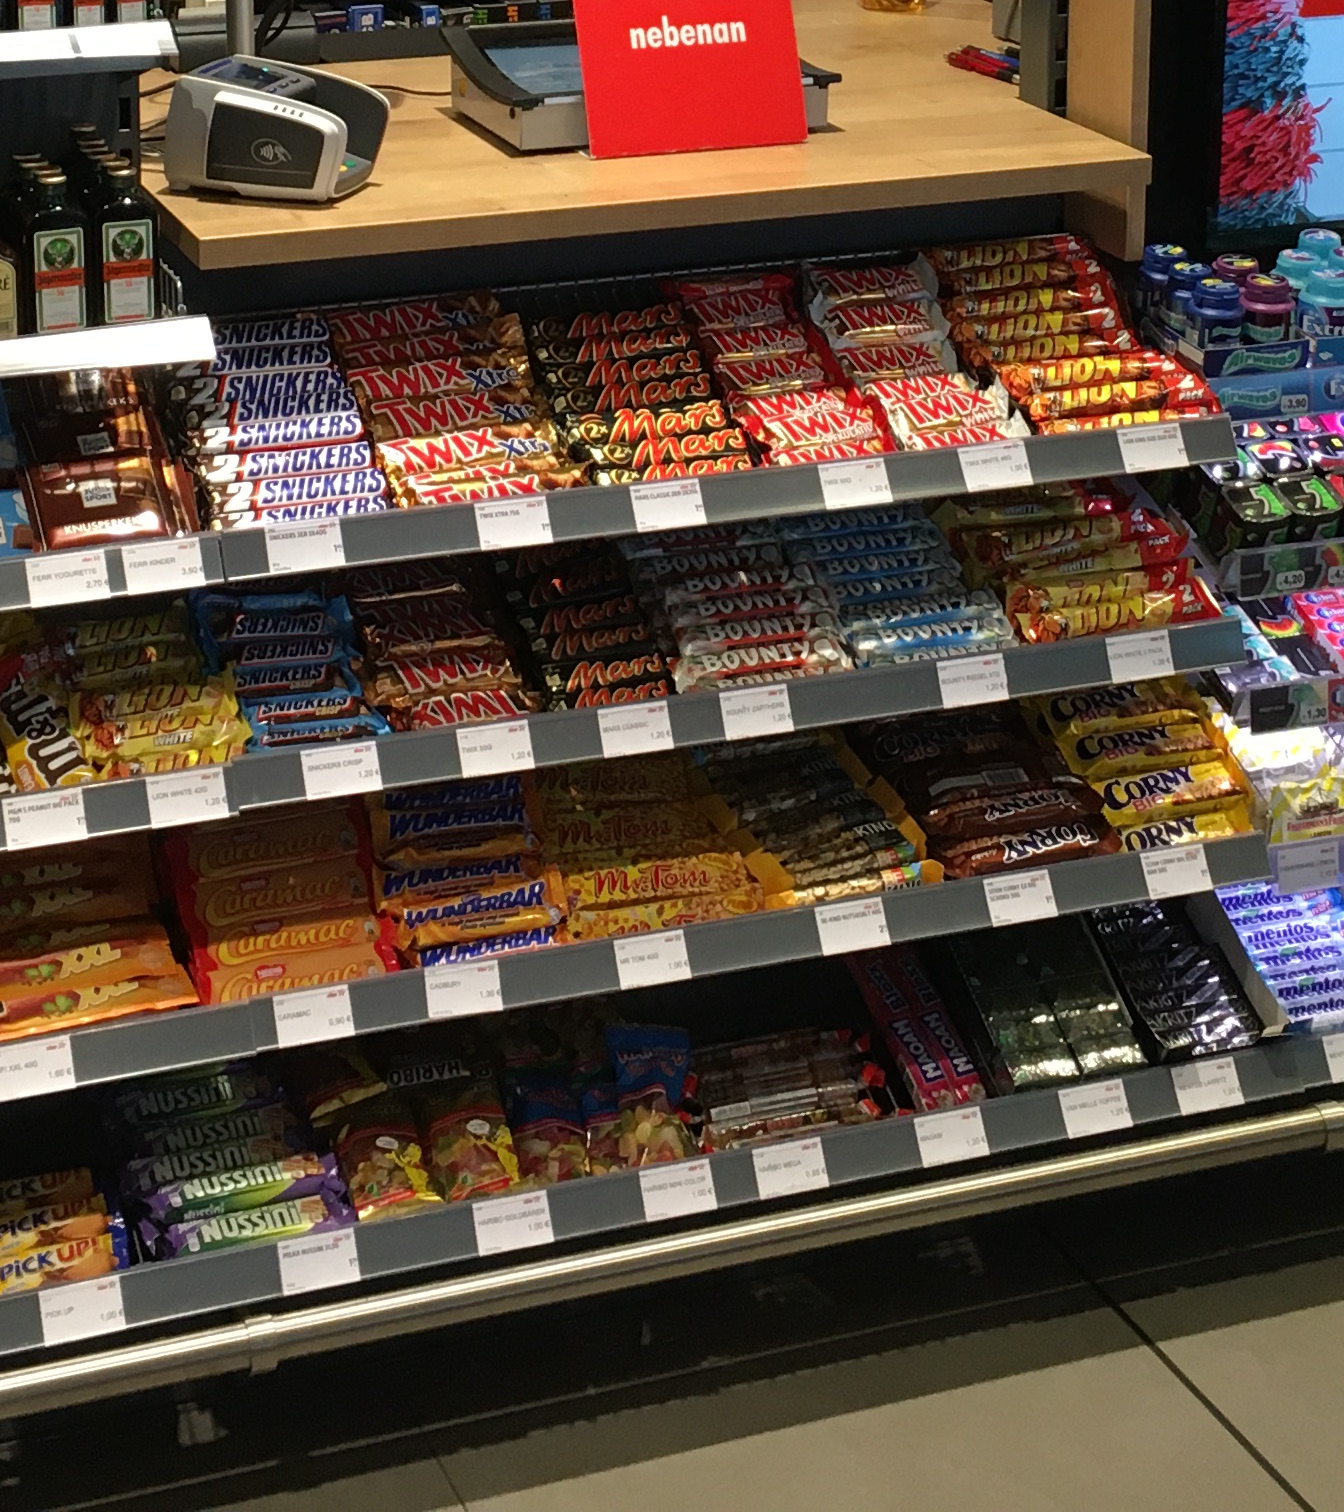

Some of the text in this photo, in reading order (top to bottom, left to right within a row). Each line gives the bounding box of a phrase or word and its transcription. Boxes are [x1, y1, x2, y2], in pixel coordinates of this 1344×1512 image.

[629, 15, 747, 50] nebenan
[1047, 357, 1121, 389] LION
[1224, 344, 1301, 374] Airwaves
[372, 393, 494, 437] TWIX
[609, 399, 726, 445] Mars
[895, 390, 998, 429] TWIX
[235, 412, 364, 448] SNICKERS
[246, 441, 371, 478] SNICKERS
[1282, 573, 1303, 585] 4,20
[1104, 764, 1195, 809] CORNY
[1132, 794, 1165, 813] BIG
[404, 879, 545, 928] WUNDERBAR
[218, 916, 355, 965] Caramac
[200, 1201, 303, 1253] NUSSINI
[56, 1235, 100, 1266] UP!
